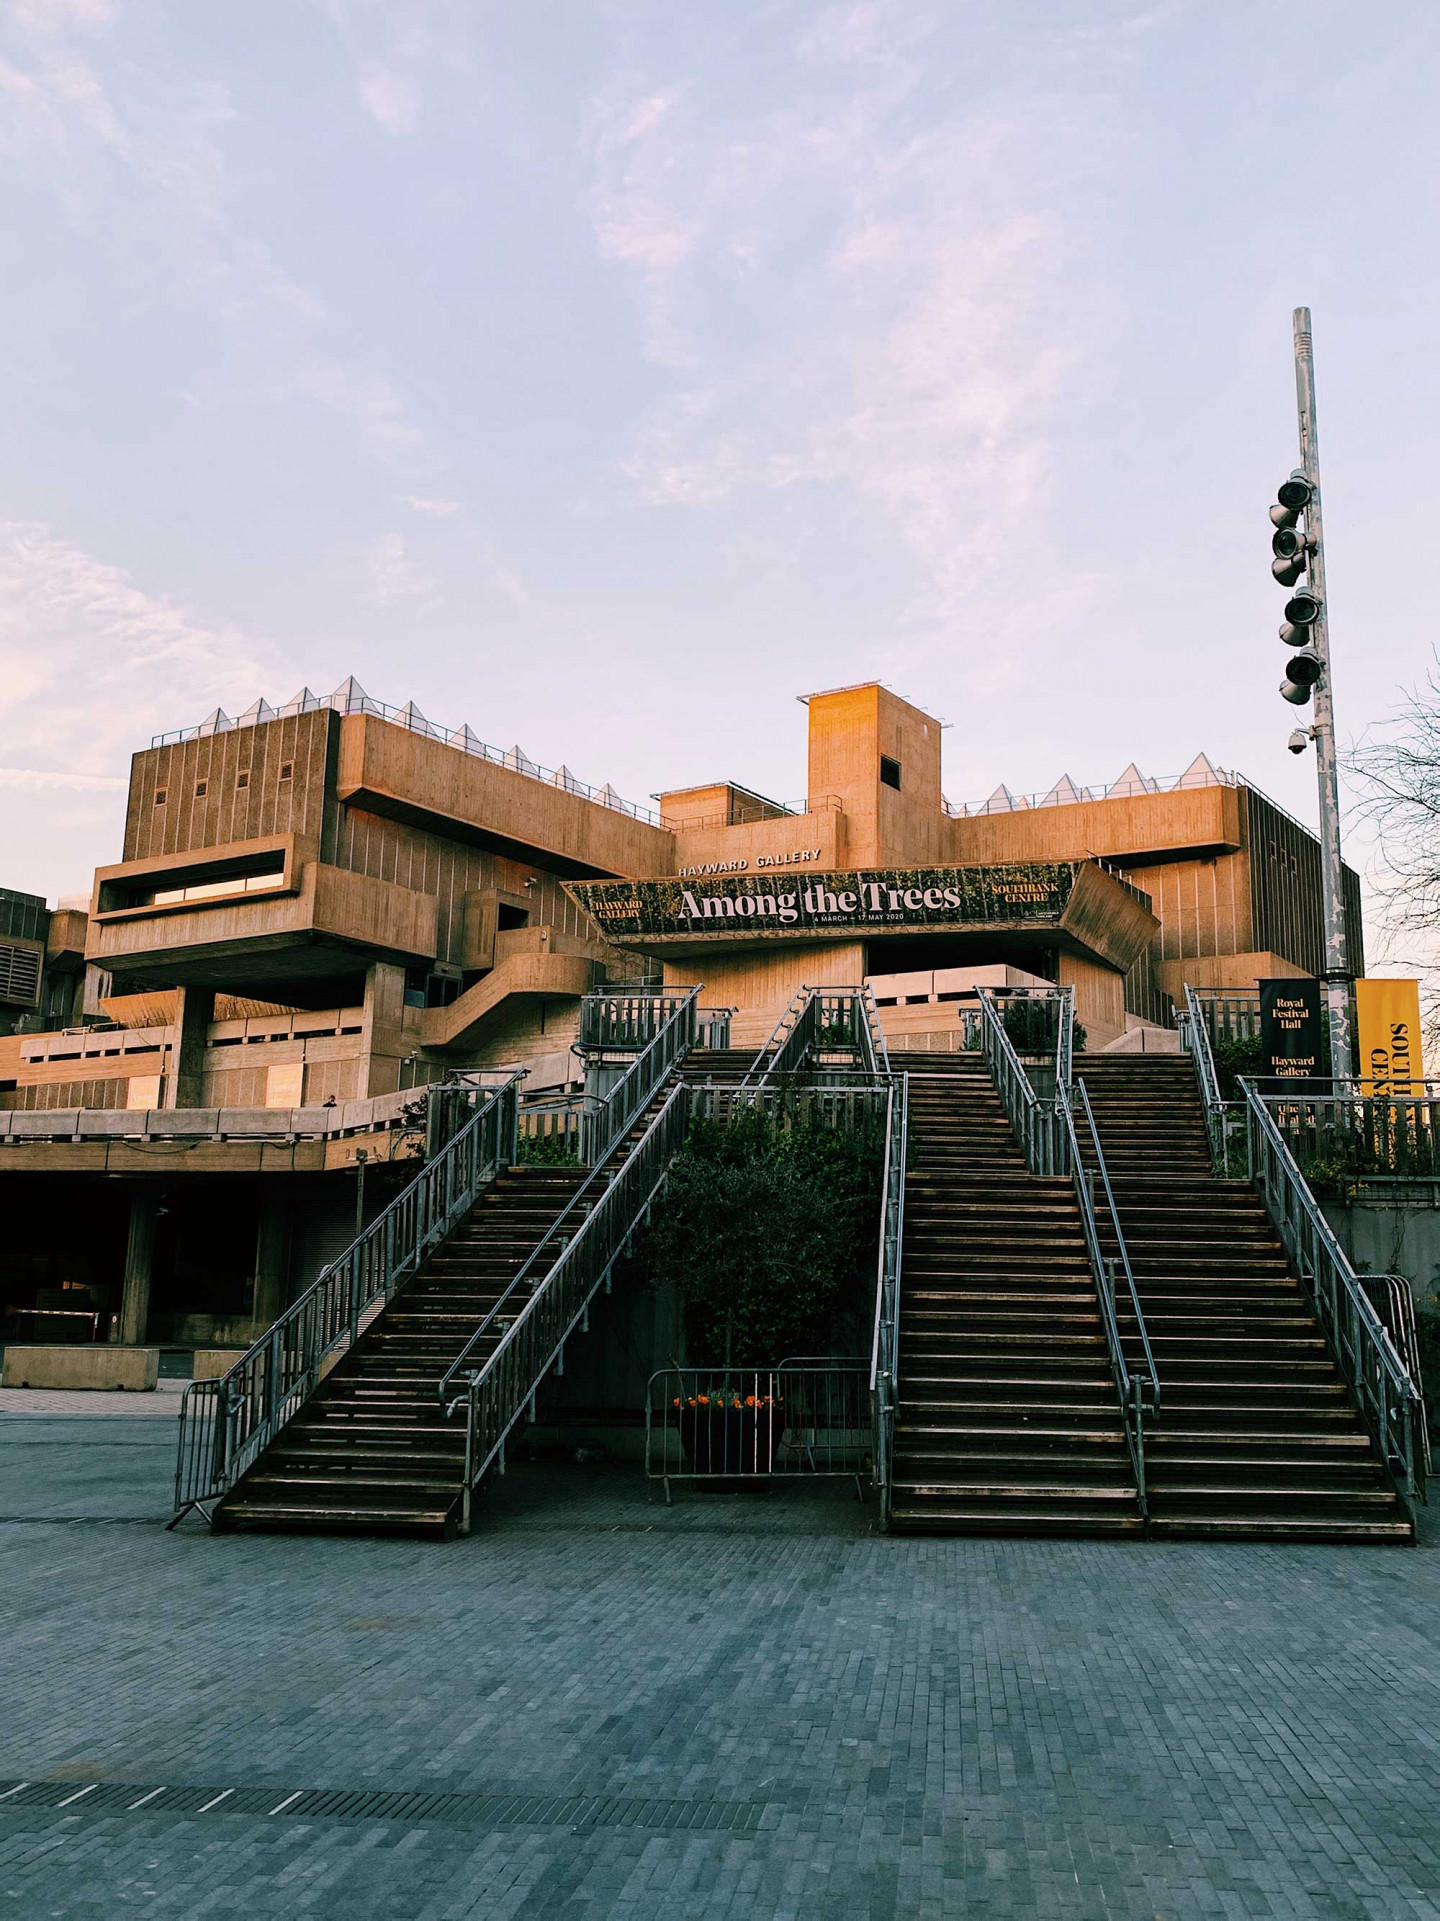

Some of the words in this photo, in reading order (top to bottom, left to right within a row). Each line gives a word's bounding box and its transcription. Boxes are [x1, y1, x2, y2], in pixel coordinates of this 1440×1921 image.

[678, 859, 748, 877] HAYWARD
[756, 849, 822, 867] GALLERY
[991, 883, 1059, 894] SOUTHBANK
[677, 890, 799, 923] Among
[803, 884, 857, 914] the
[862, 882, 961, 911] Trees
[1004, 893, 1049, 903] CENTRE
[595, 900, 643, 910] HAYWARD
[598, 909, 640, 919] GALLERY
[1276, 998, 1304, 1010] Royal
[1272, 1008, 1309, 1018] Festival
[1281, 1019, 1301, 1029] Hall
[1271, 1056, 1315, 1068] Hayward
[1275, 1066, 1311, 1077] Gallery
